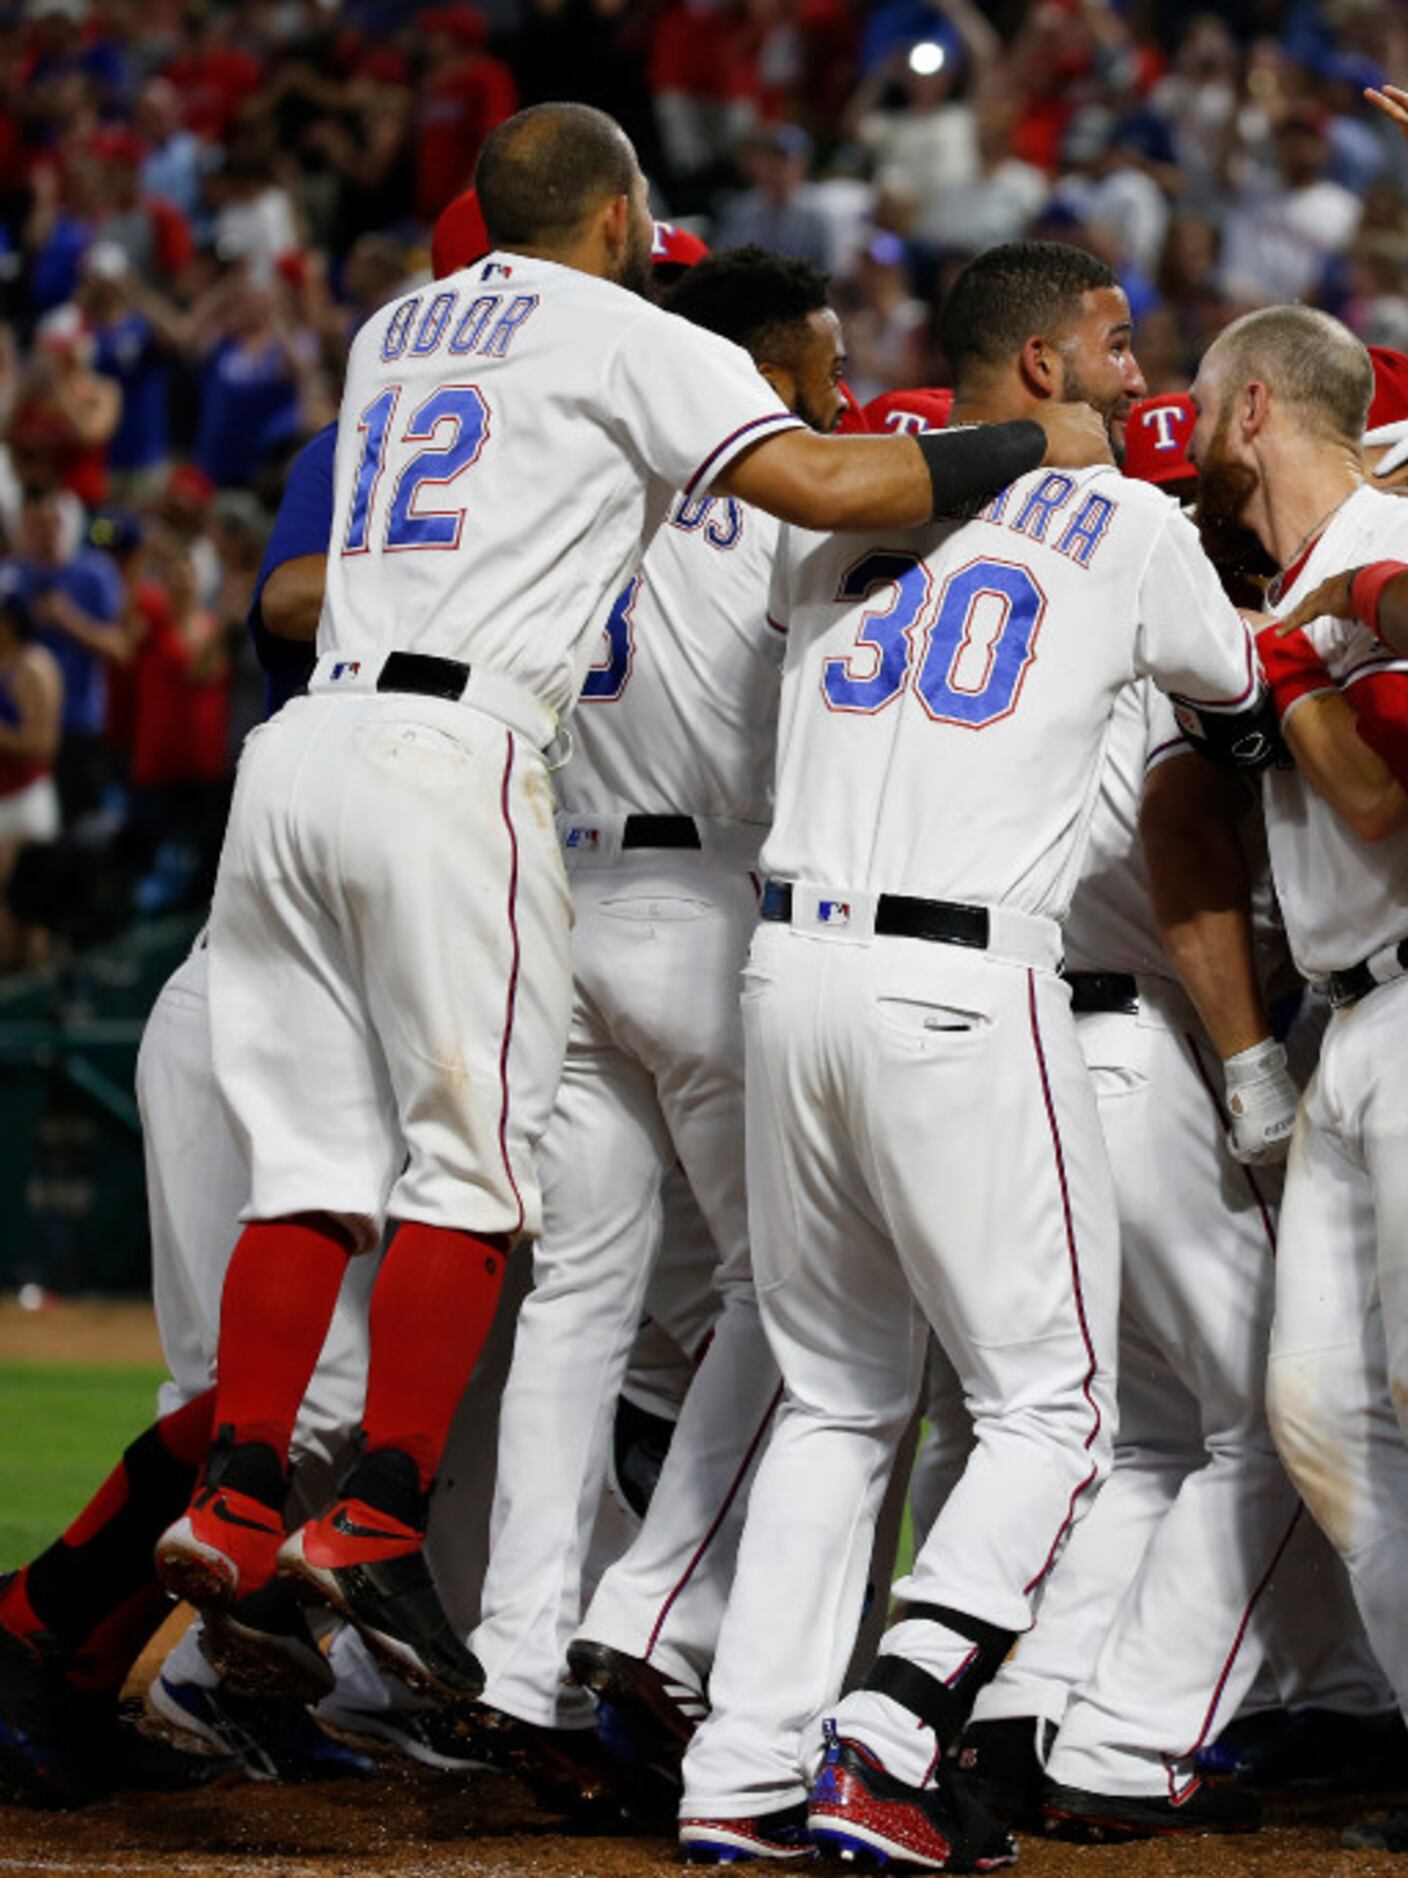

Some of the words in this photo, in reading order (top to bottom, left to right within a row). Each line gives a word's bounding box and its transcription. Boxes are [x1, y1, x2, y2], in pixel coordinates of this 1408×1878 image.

[380, 290, 540, 363] ODOR
[341, 384, 492, 556] 12
[1142, 405, 1188, 450] T
[820, 547, 1049, 730] 30
